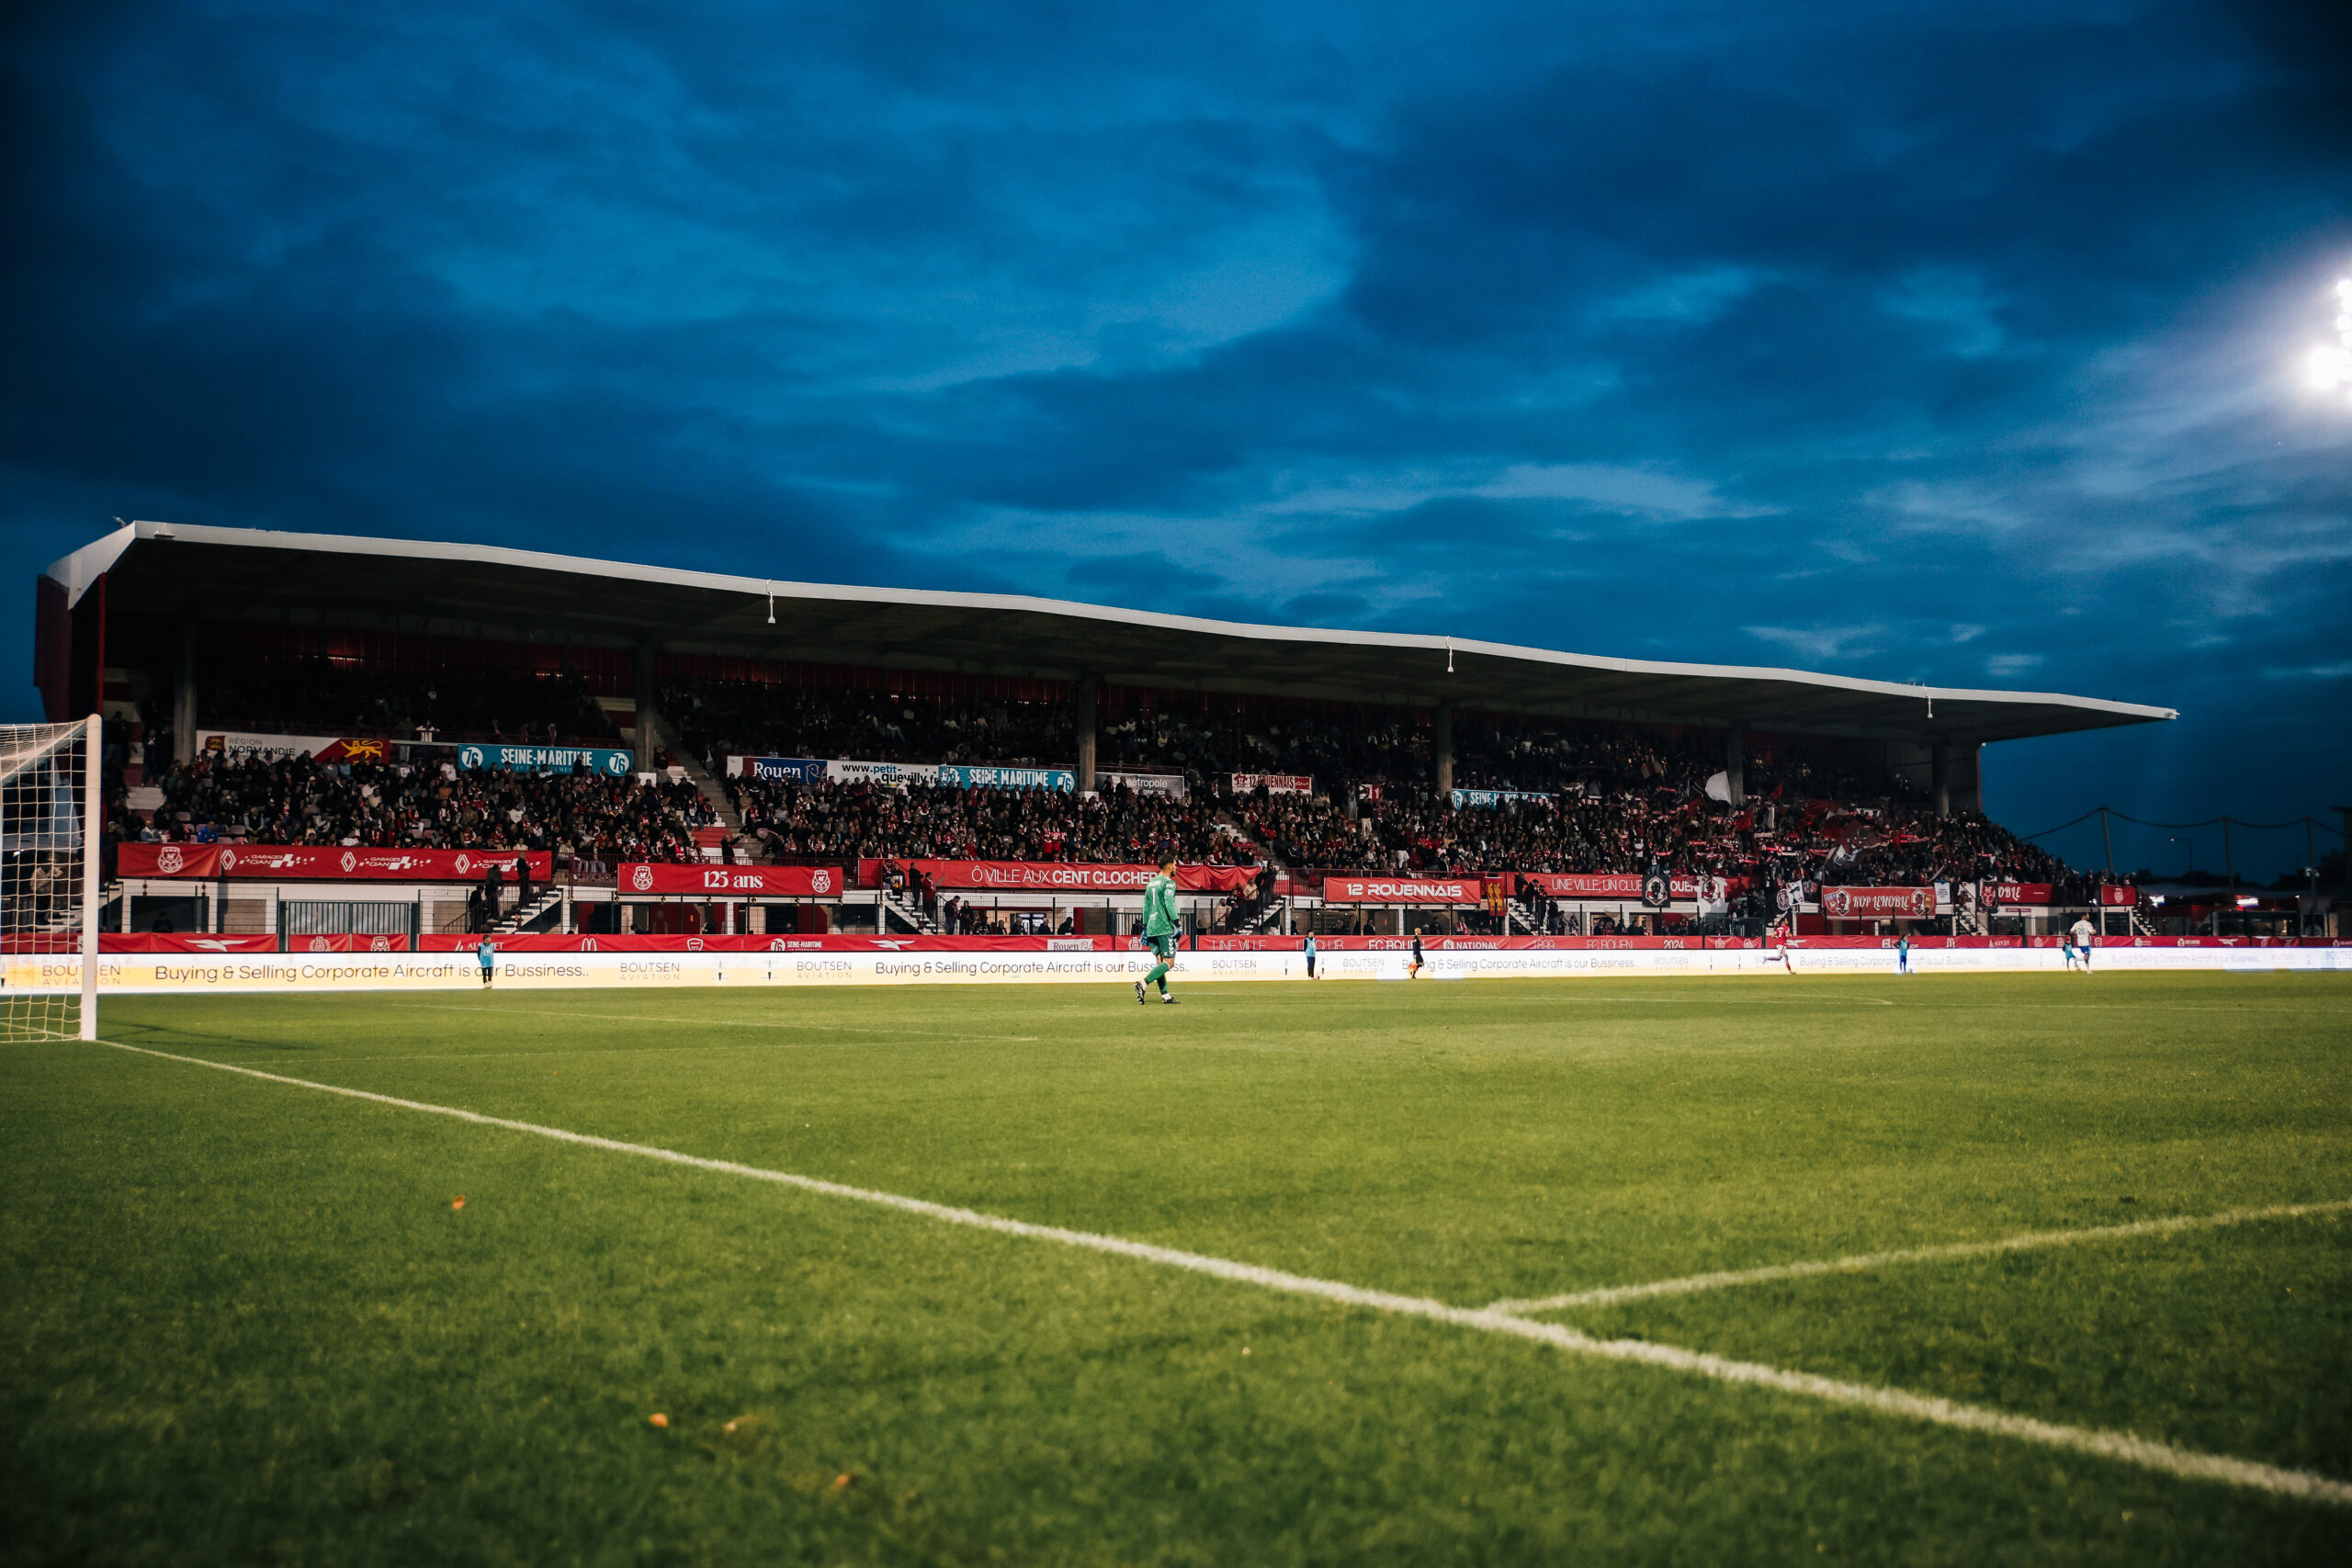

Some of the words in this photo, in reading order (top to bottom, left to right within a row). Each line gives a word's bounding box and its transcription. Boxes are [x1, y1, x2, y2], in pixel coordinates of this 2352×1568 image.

[229, 737, 263, 746] RÉGION
[229, 745, 296, 756] NORMANDIE
[752, 761, 801, 780] Rouen
[1250, 775, 1256, 787] 12
[704, 871, 729, 888] 125
[733, 873, 763, 889] ans
[971, 865, 983, 883] Ô
[985, 868, 1021, 883] VILLE
[1023, 869, 1050, 884] AUX
[1052, 870, 1091, 885] CENT
[1092, 871, 1161, 886] CLOCHER
[1347, 884, 1363, 896] 12
[1367, 884, 1463, 897] ROUENNAIS
[1551, 879, 1572, 891] UNE
[1602, 879, 1617, 891] UN
[1670, 880, 1697, 892] OUEN
[1151, 887, 1157, 906] 1
[1852, 895, 1872, 908] KOP
[1054, 942, 1079, 951] Rouen
[1368, 940, 1384, 950] FC
[1456, 942, 1498, 950] NATIONAL
[1664, 939, 1685, 949] 2024
[620, 963, 680, 973] BOUTSEN
[797, 961, 852, 971] BOUTSEN
[1212, 959, 1257, 969] BOUTSEN
[1342, 958, 1384, 967] BOUTSEN
[1438, 959, 1445, 970] &
[1446, 958, 1477, 972] Selling
[1479, 958, 1527, 972] Corporate
[1529, 958, 1563, 969] Aircraft
[1565, 958, 1572, 968] is
[1573, 960, 1589, 968] our
[1800, 956, 1826, 968] Buying
[1833, 956, 1859, 968] Selling
[1860, 956, 1897, 967] Corporate
[42, 965, 120, 976] BOUEN
[154, 965, 218, 983] Buying
[222, 965, 234, 979] &
[239, 964, 297, 982] Selling
[301, 964, 389, 981] Corporate
[393, 964, 454, 977] Aircraft
[458, 964, 470, 976] is
[475, 966, 501, 976] or
[876, 962, 920, 976] Buying
[923, 962, 932, 973] &
[934, 961, 976, 976] Selling
[980, 961, 1044, 976] Corporate
[1047, 961, 1091, 973] Aircraft
[1094, 961, 1103, 973] is
[1105, 964, 1124, 973] our
[1128, 961, 1190, 973] Bussess..
